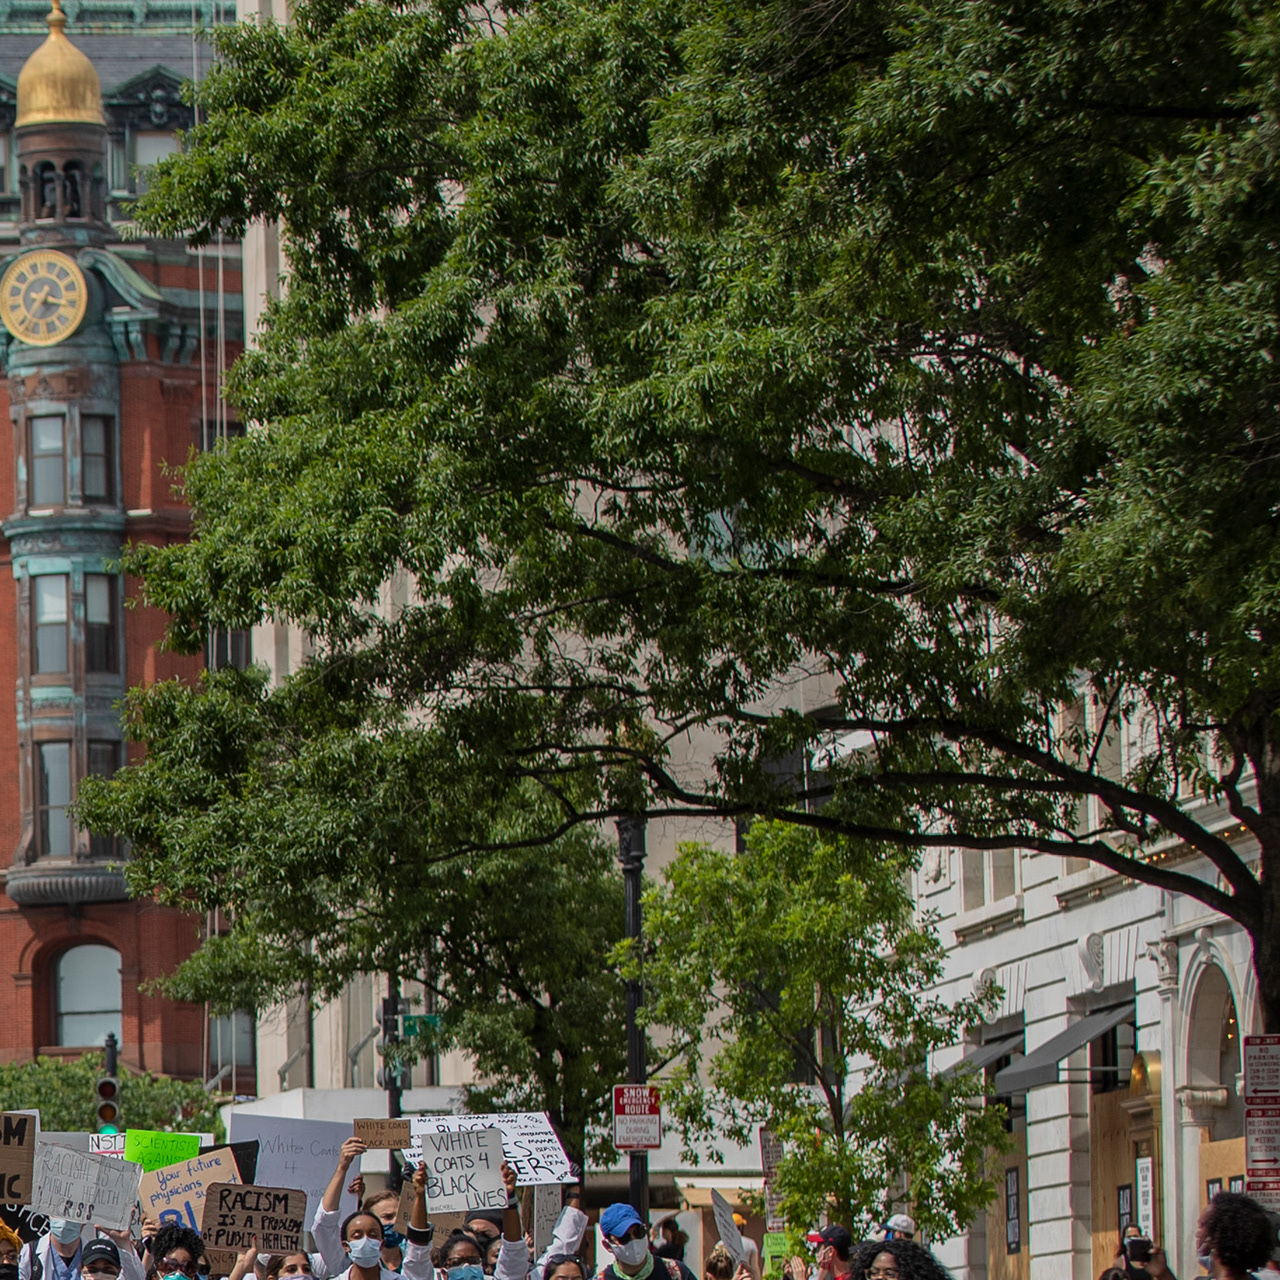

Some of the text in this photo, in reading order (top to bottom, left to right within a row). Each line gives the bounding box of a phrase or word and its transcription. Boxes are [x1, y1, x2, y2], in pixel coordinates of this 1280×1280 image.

[623, 1088, 650, 1098] SNOW
[625, 1105, 650, 1114] ROUTE
[133, 1136, 197, 1155] SCIENTISTS
[258, 1134, 340, 1157] White Coats
[430, 1130, 488, 1153] WHITE
[156, 1156, 222, 1191] Your future
[285, 1161, 298, 1173] 4
[434, 1153, 490, 1174] COATS 4
[150, 1180, 203, 1207] physicians
[427, 1172, 479, 1199] BLACK
[219, 1188, 289, 1214] RACISM
[466, 1188, 507, 1211] LIVES
[217, 1214, 302, 1234] IS A PROBLEM
[202, 1227, 213, 1240] of
[262, 1233, 299, 1251] HEALTH
